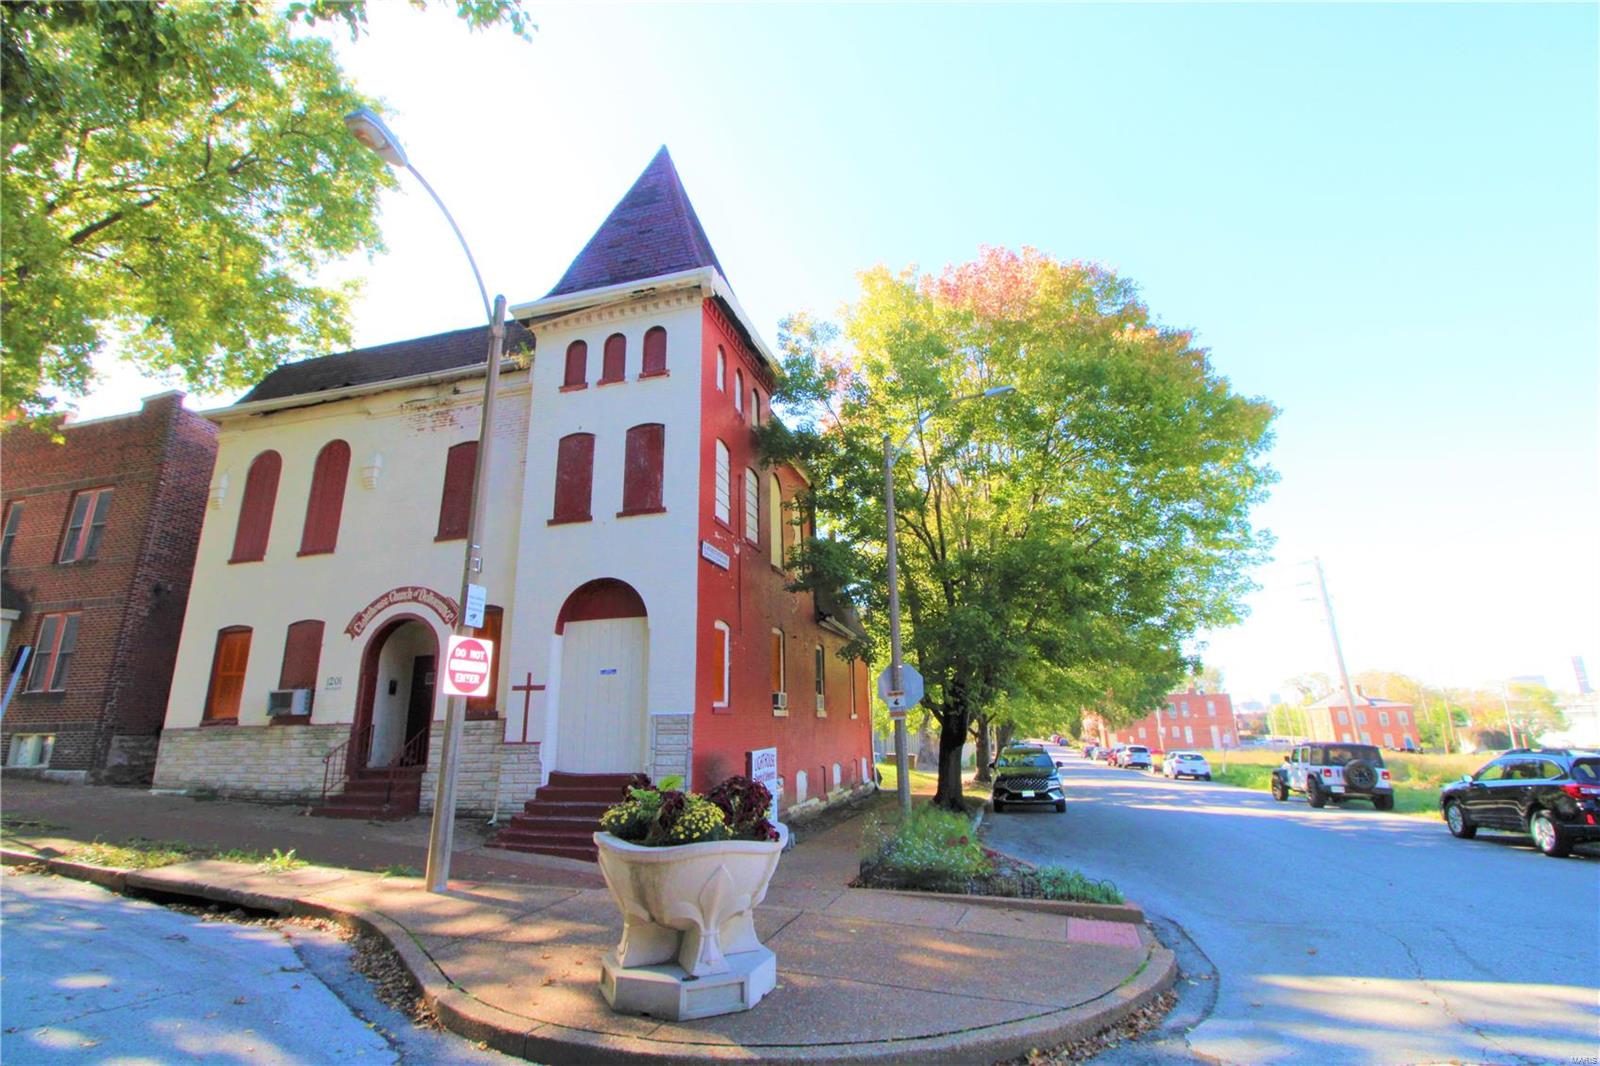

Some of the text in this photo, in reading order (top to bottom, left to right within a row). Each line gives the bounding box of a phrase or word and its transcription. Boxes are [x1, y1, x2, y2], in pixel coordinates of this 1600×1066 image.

[389, 587, 413, 602] Church
[455, 647, 486, 660] DO NOT
